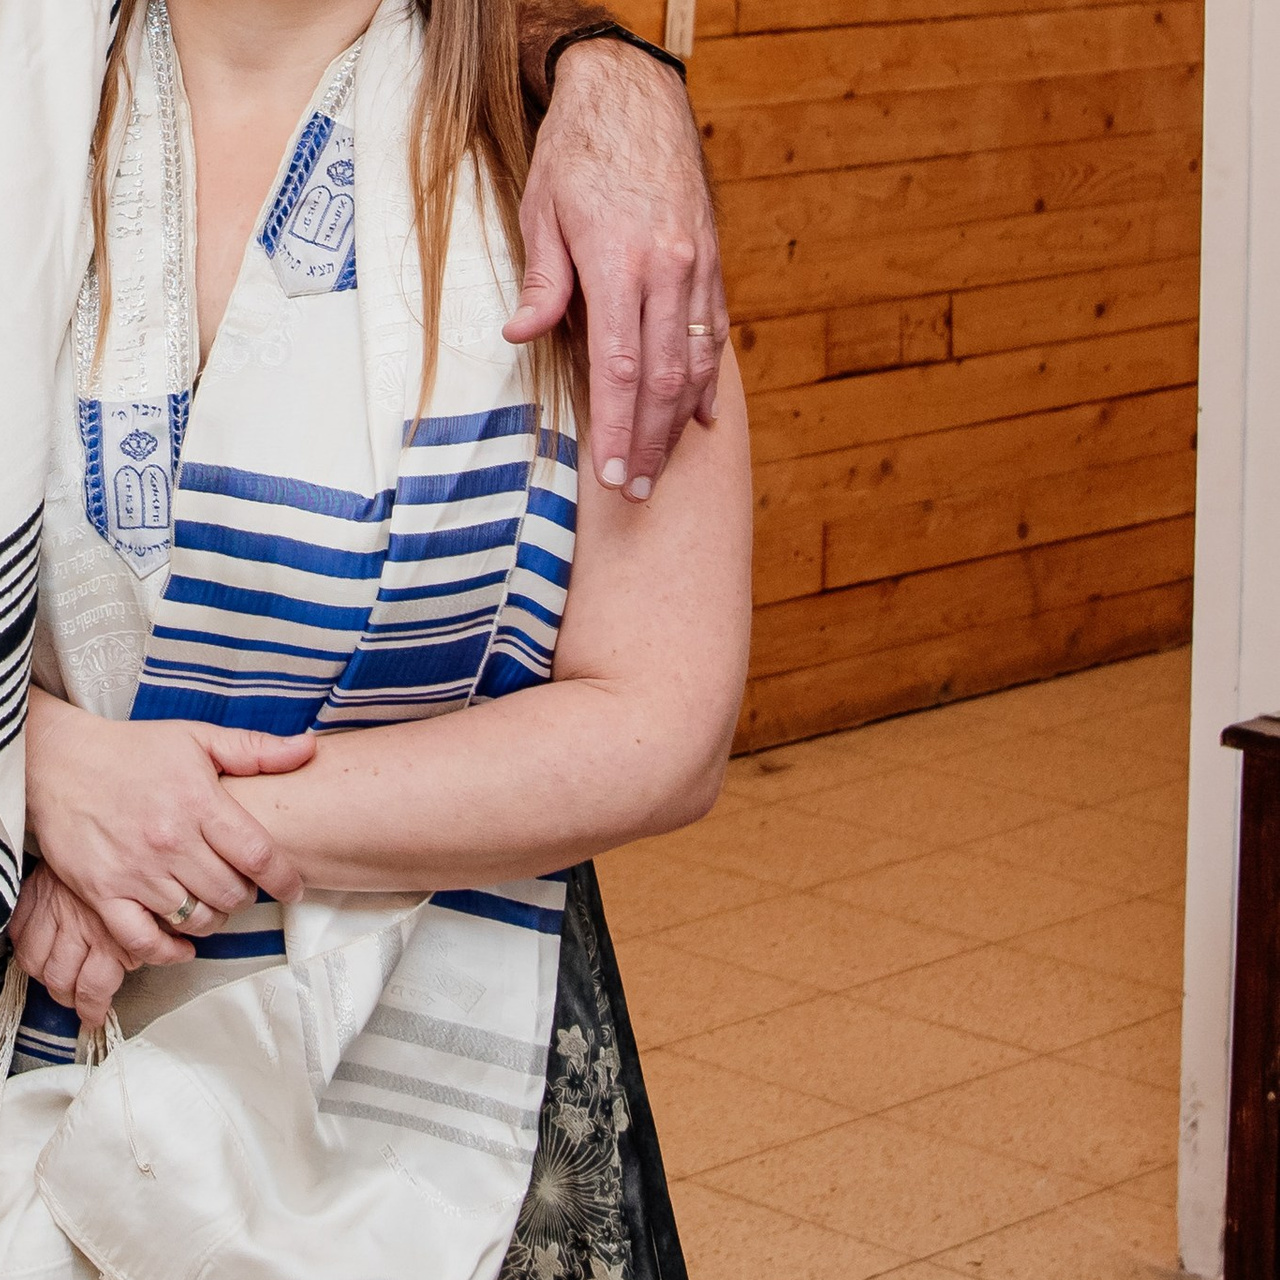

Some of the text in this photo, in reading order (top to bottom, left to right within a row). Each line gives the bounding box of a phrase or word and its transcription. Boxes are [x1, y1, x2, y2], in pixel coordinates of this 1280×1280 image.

[278, 244, 335, 277] תצא תורה
[132, 403, 162, 418] ודבר
[114, 538, 171, 558] מירושלים
